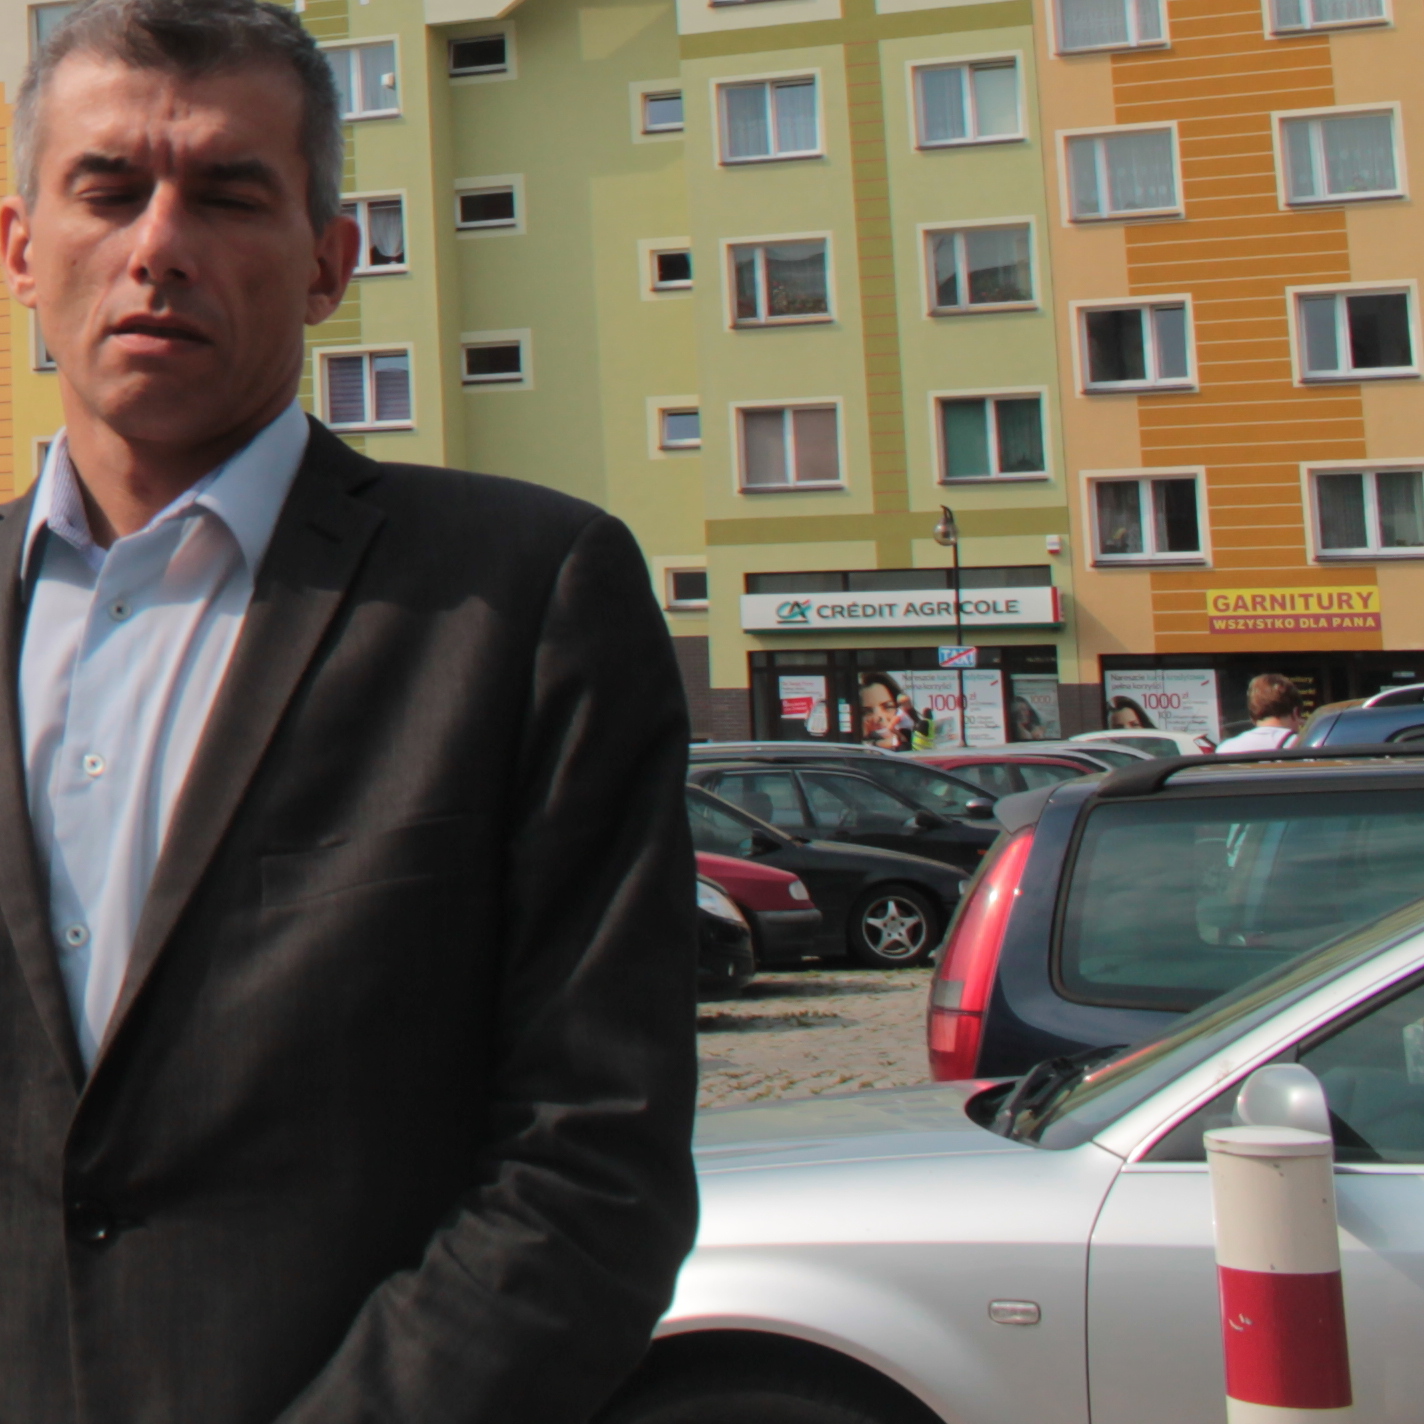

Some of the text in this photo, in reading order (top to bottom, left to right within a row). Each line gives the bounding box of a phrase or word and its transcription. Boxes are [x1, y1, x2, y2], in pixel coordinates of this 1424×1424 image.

[816, 599, 1019, 619] CRÉDIT AGRICOLE
[1212, 592, 1374, 613] GARNITURY
[1212, 616, 1376, 630] WSZYSTKO DLA PANA
[928, 694, 968, 711] 1000
[1141, 693, 1180, 710] 1000
